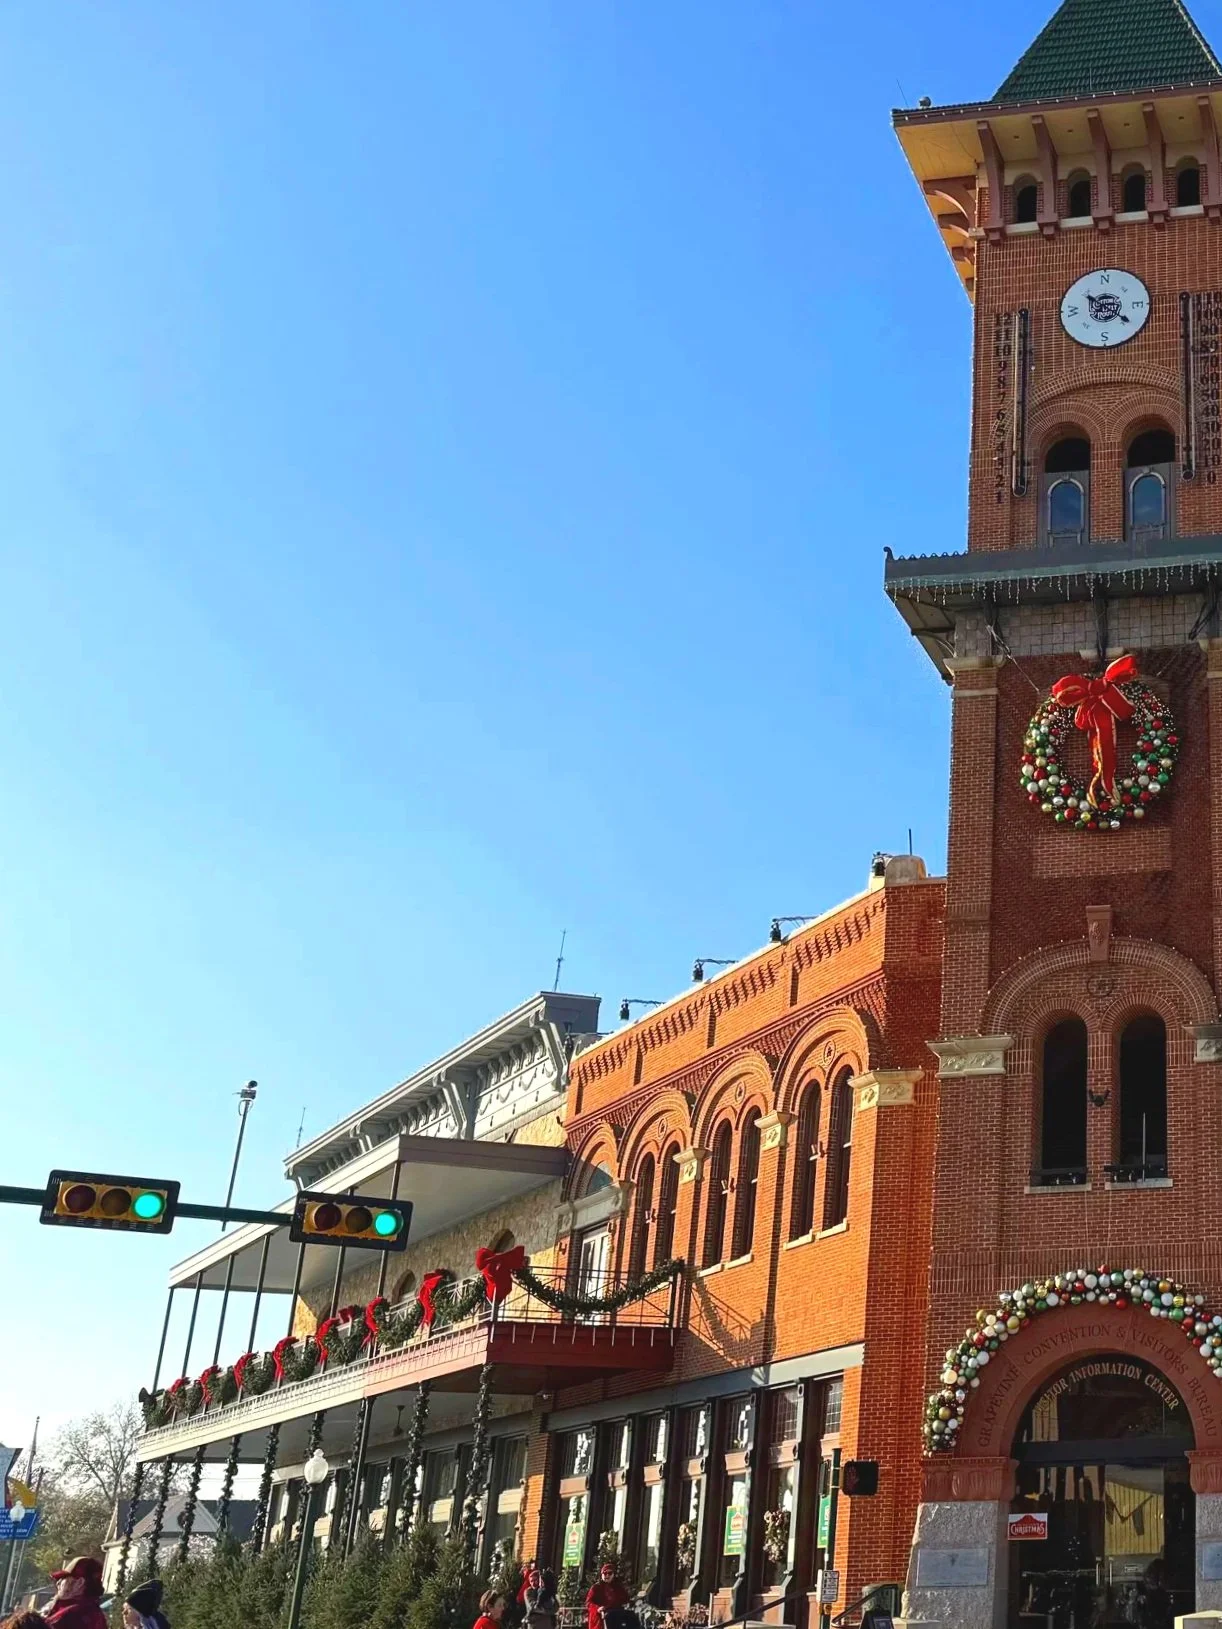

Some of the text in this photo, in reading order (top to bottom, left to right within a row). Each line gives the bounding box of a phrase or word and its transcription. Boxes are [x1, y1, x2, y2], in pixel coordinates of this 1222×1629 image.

[1100, 274, 1110, 285] N
[1067, 305, 1079, 318] W
[1132, 301, 1144, 310] E
[1100, 331, 1110, 342] S
[979, 1325, 1217, 1448] GRAPEVINE CONVENTION & VISITORS BUREAU
[1144, 1373, 1179, 1410] CENTER
